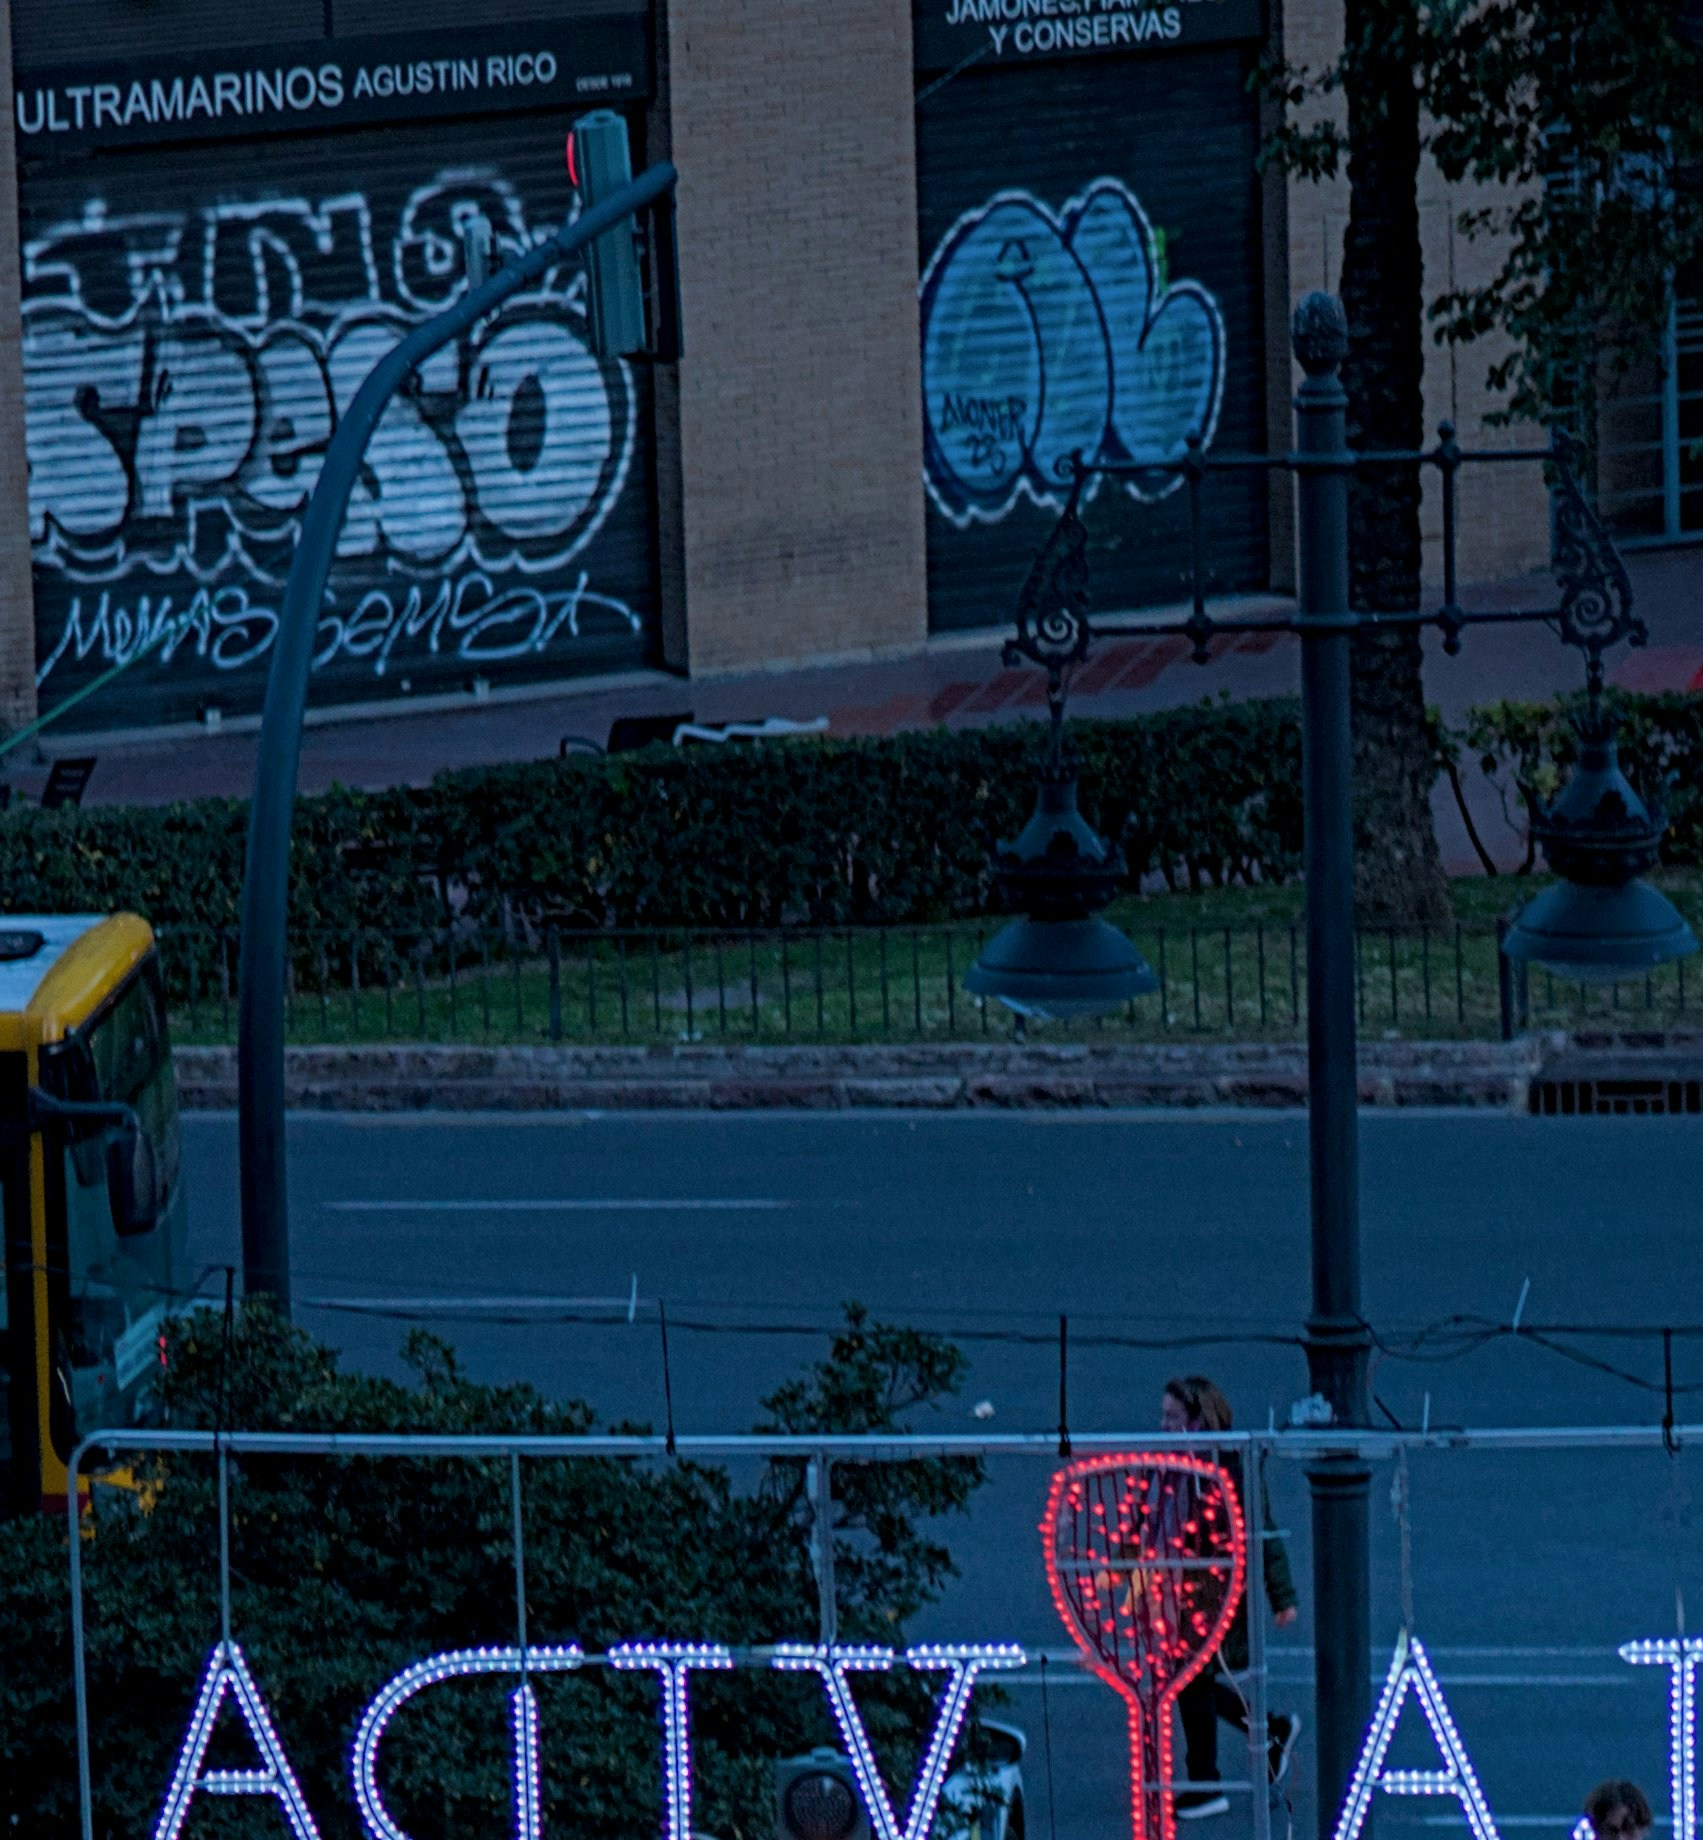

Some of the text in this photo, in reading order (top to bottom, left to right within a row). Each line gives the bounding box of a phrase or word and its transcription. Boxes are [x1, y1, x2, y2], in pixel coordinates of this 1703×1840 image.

[988, 7, 1182, 54] Y CONSERVAS
[17, 51, 557, 134] ULTRAMARINOS AGUSTIN RICO
